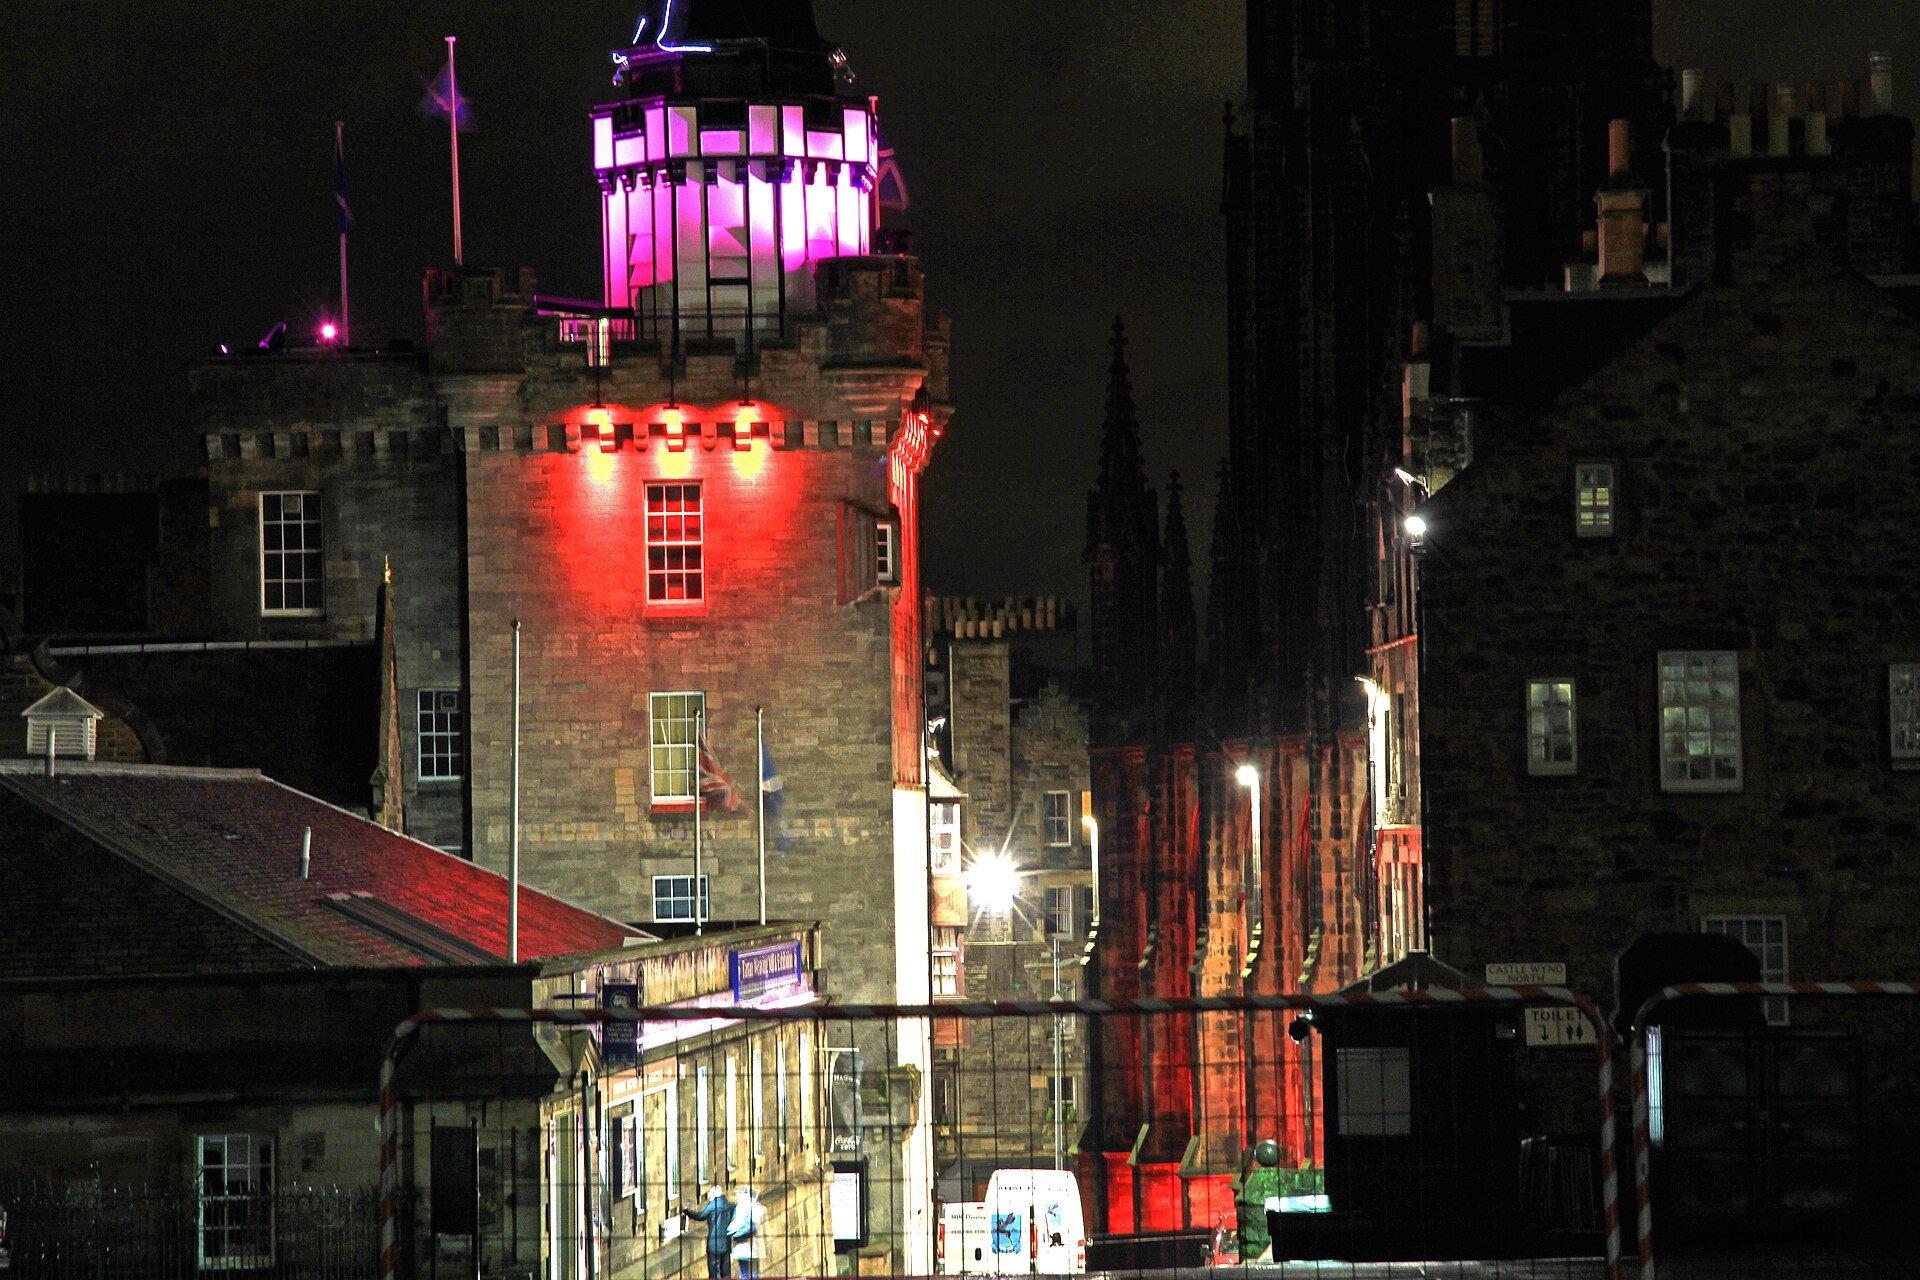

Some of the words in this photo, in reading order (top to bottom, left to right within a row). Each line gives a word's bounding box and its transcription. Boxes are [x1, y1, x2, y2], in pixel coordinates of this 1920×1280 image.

[1488, 964, 1526, 974] CASTLE
[1529, 963, 1563, 974] WYND
[1507, 974, 1545, 983] NORTH
